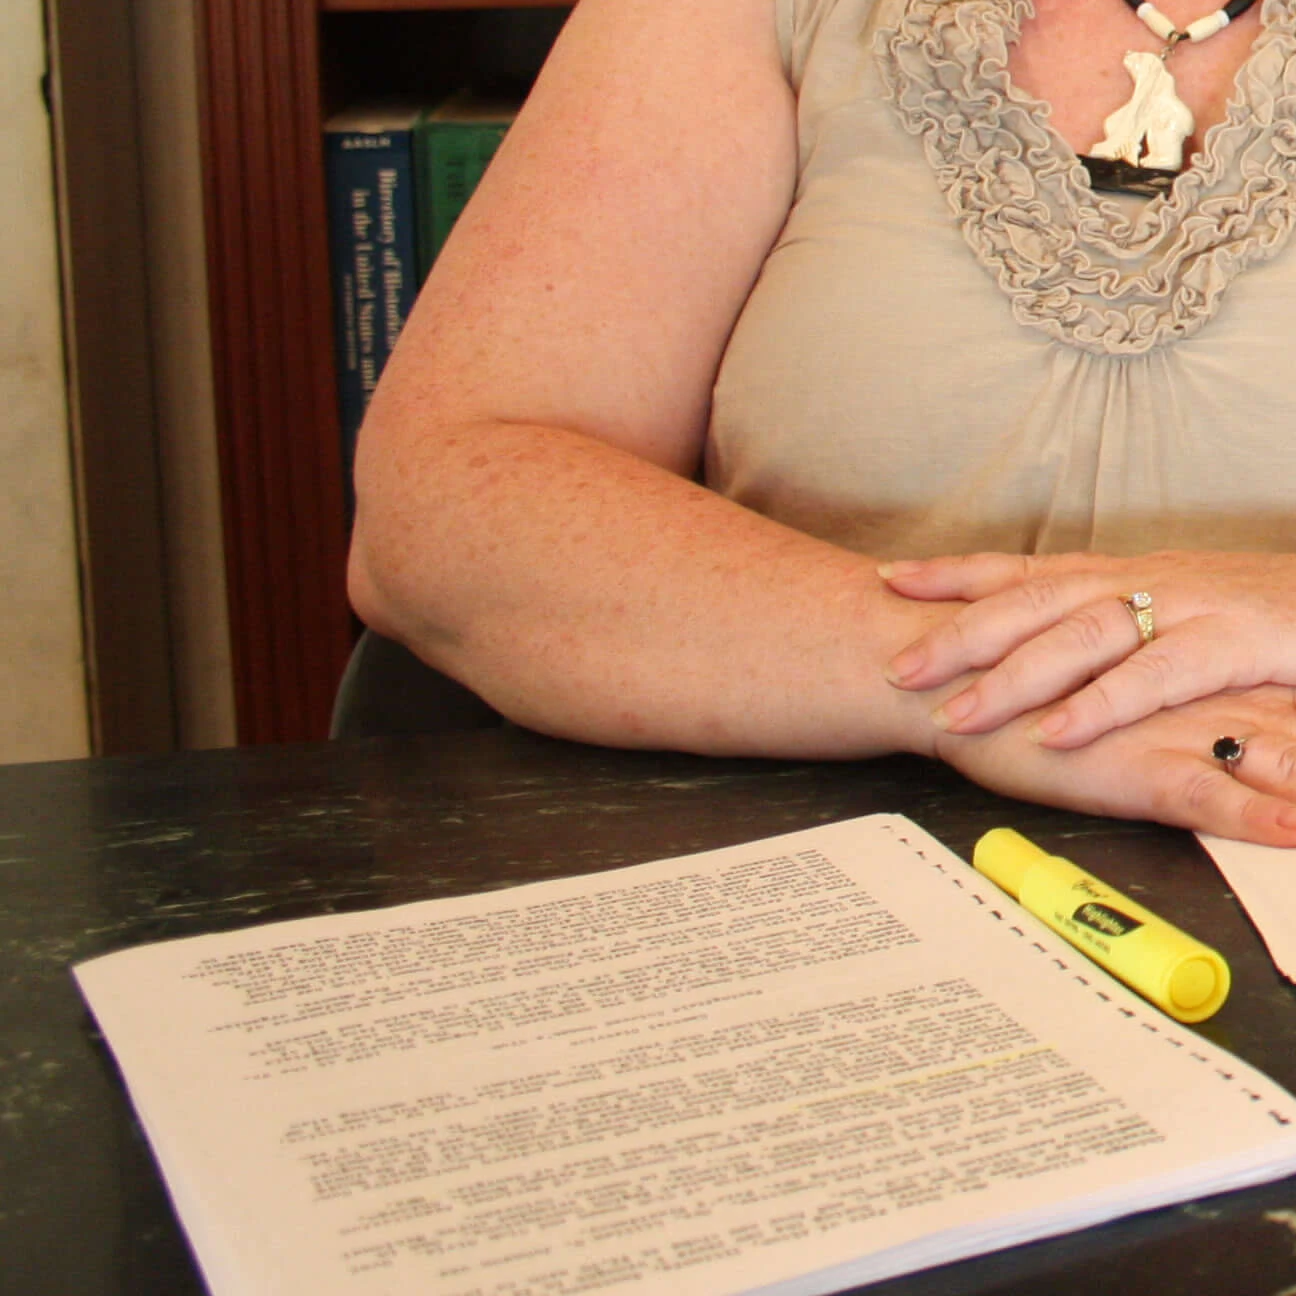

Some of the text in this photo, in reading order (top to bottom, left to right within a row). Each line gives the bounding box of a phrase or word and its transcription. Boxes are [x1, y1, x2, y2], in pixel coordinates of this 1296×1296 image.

[378, 169, 398, 243] Directory
[352, 189, 376, 390] in the United States and
[382, 248, 401, 266] of
